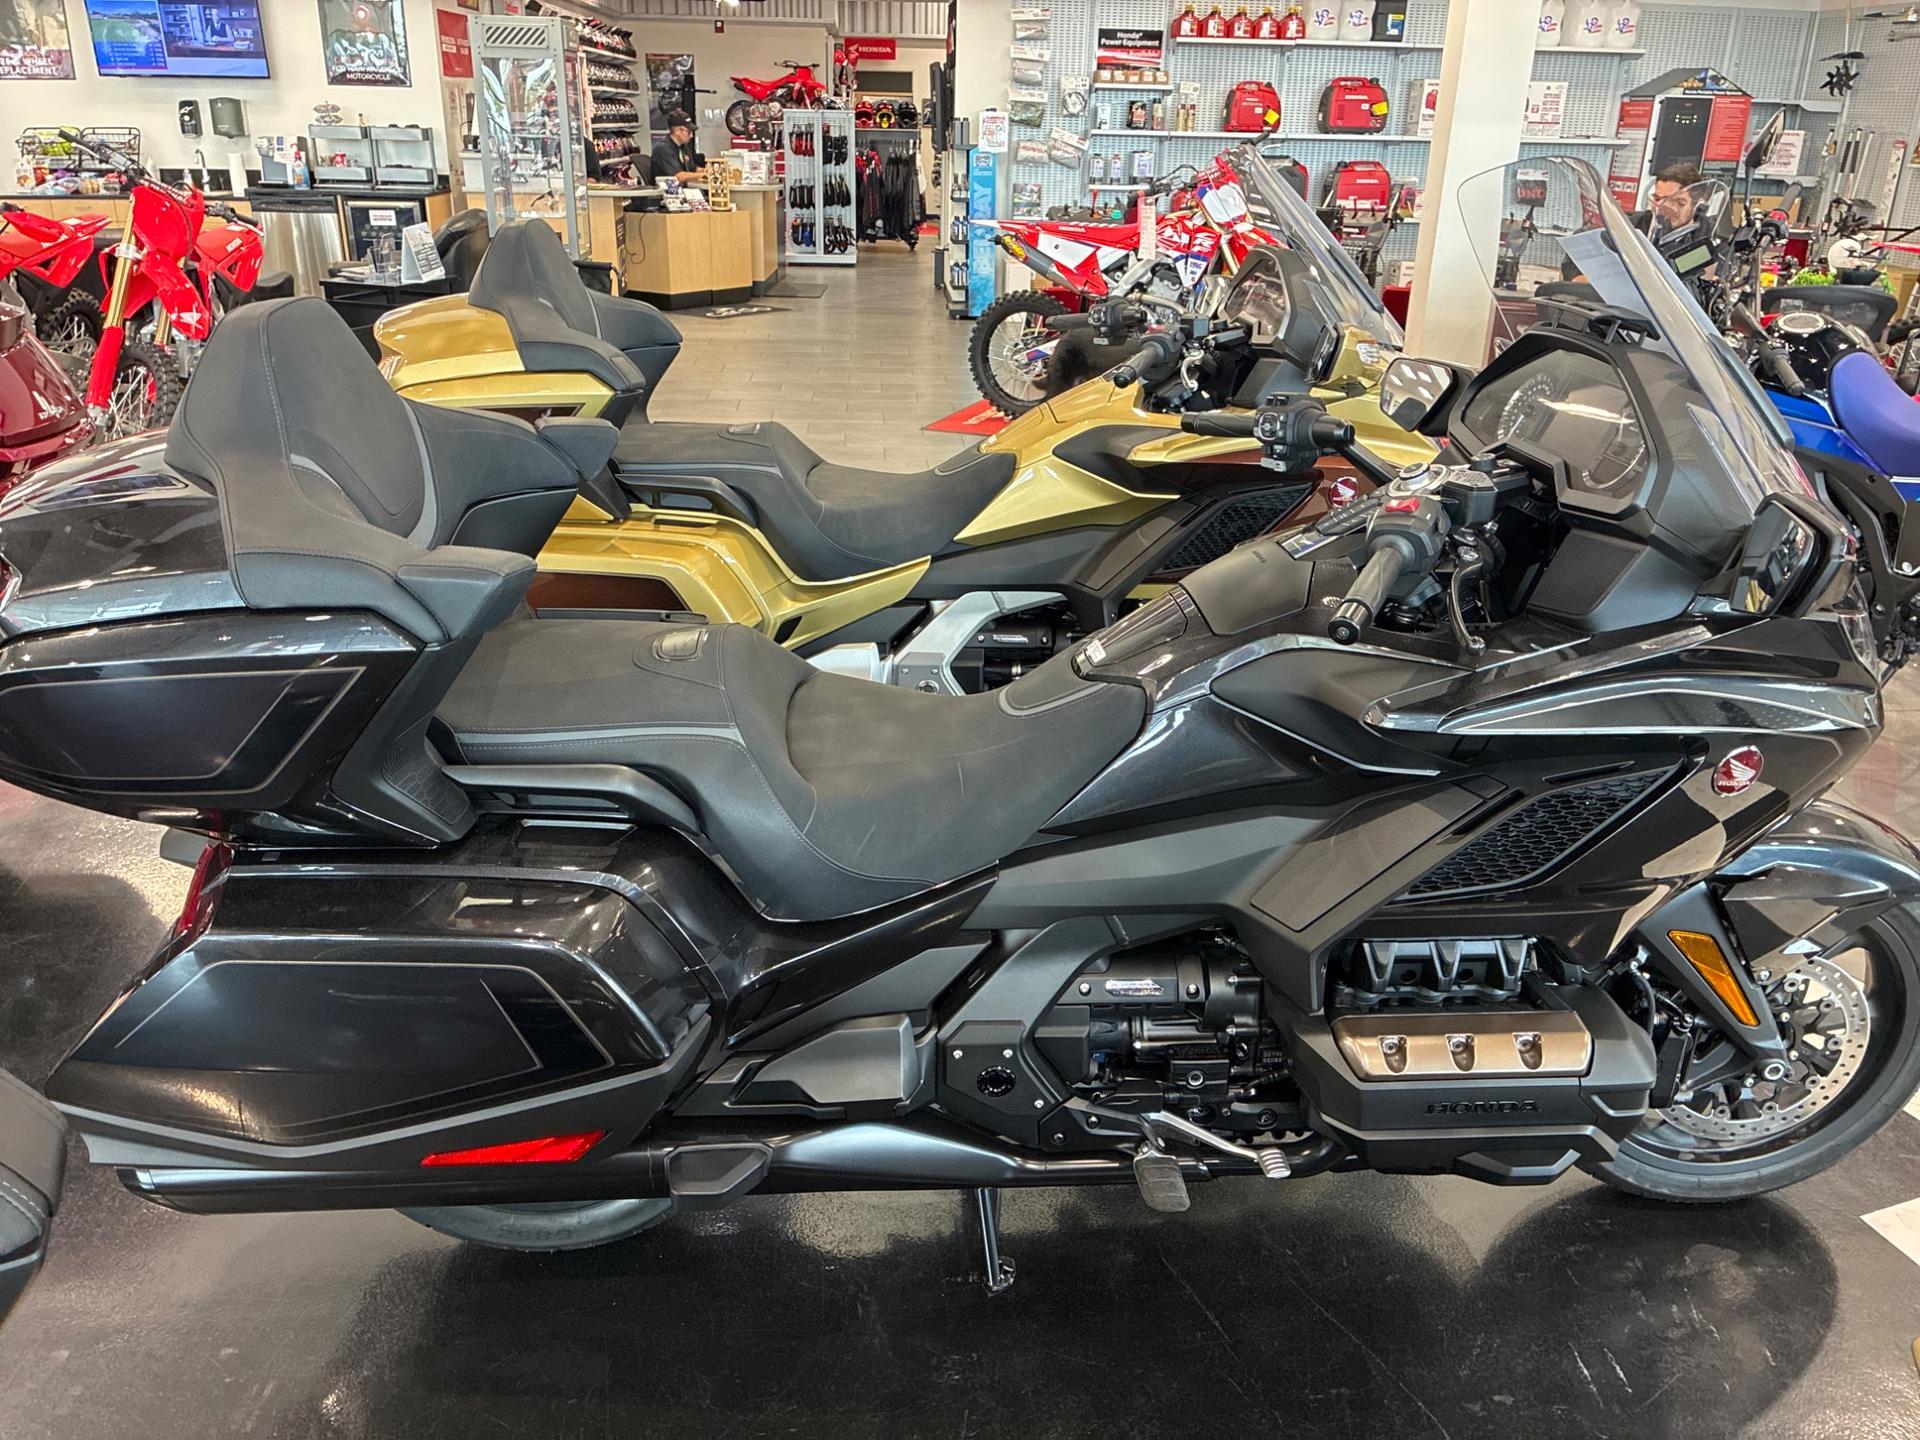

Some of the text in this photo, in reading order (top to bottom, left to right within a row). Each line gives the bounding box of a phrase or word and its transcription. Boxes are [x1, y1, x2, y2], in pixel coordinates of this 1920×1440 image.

[1100, 38, 1160, 48] Power Equipment
[346, 72, 392, 81] MOTORCYCLE
[1425, 1100, 1541, 1114] HONDA
